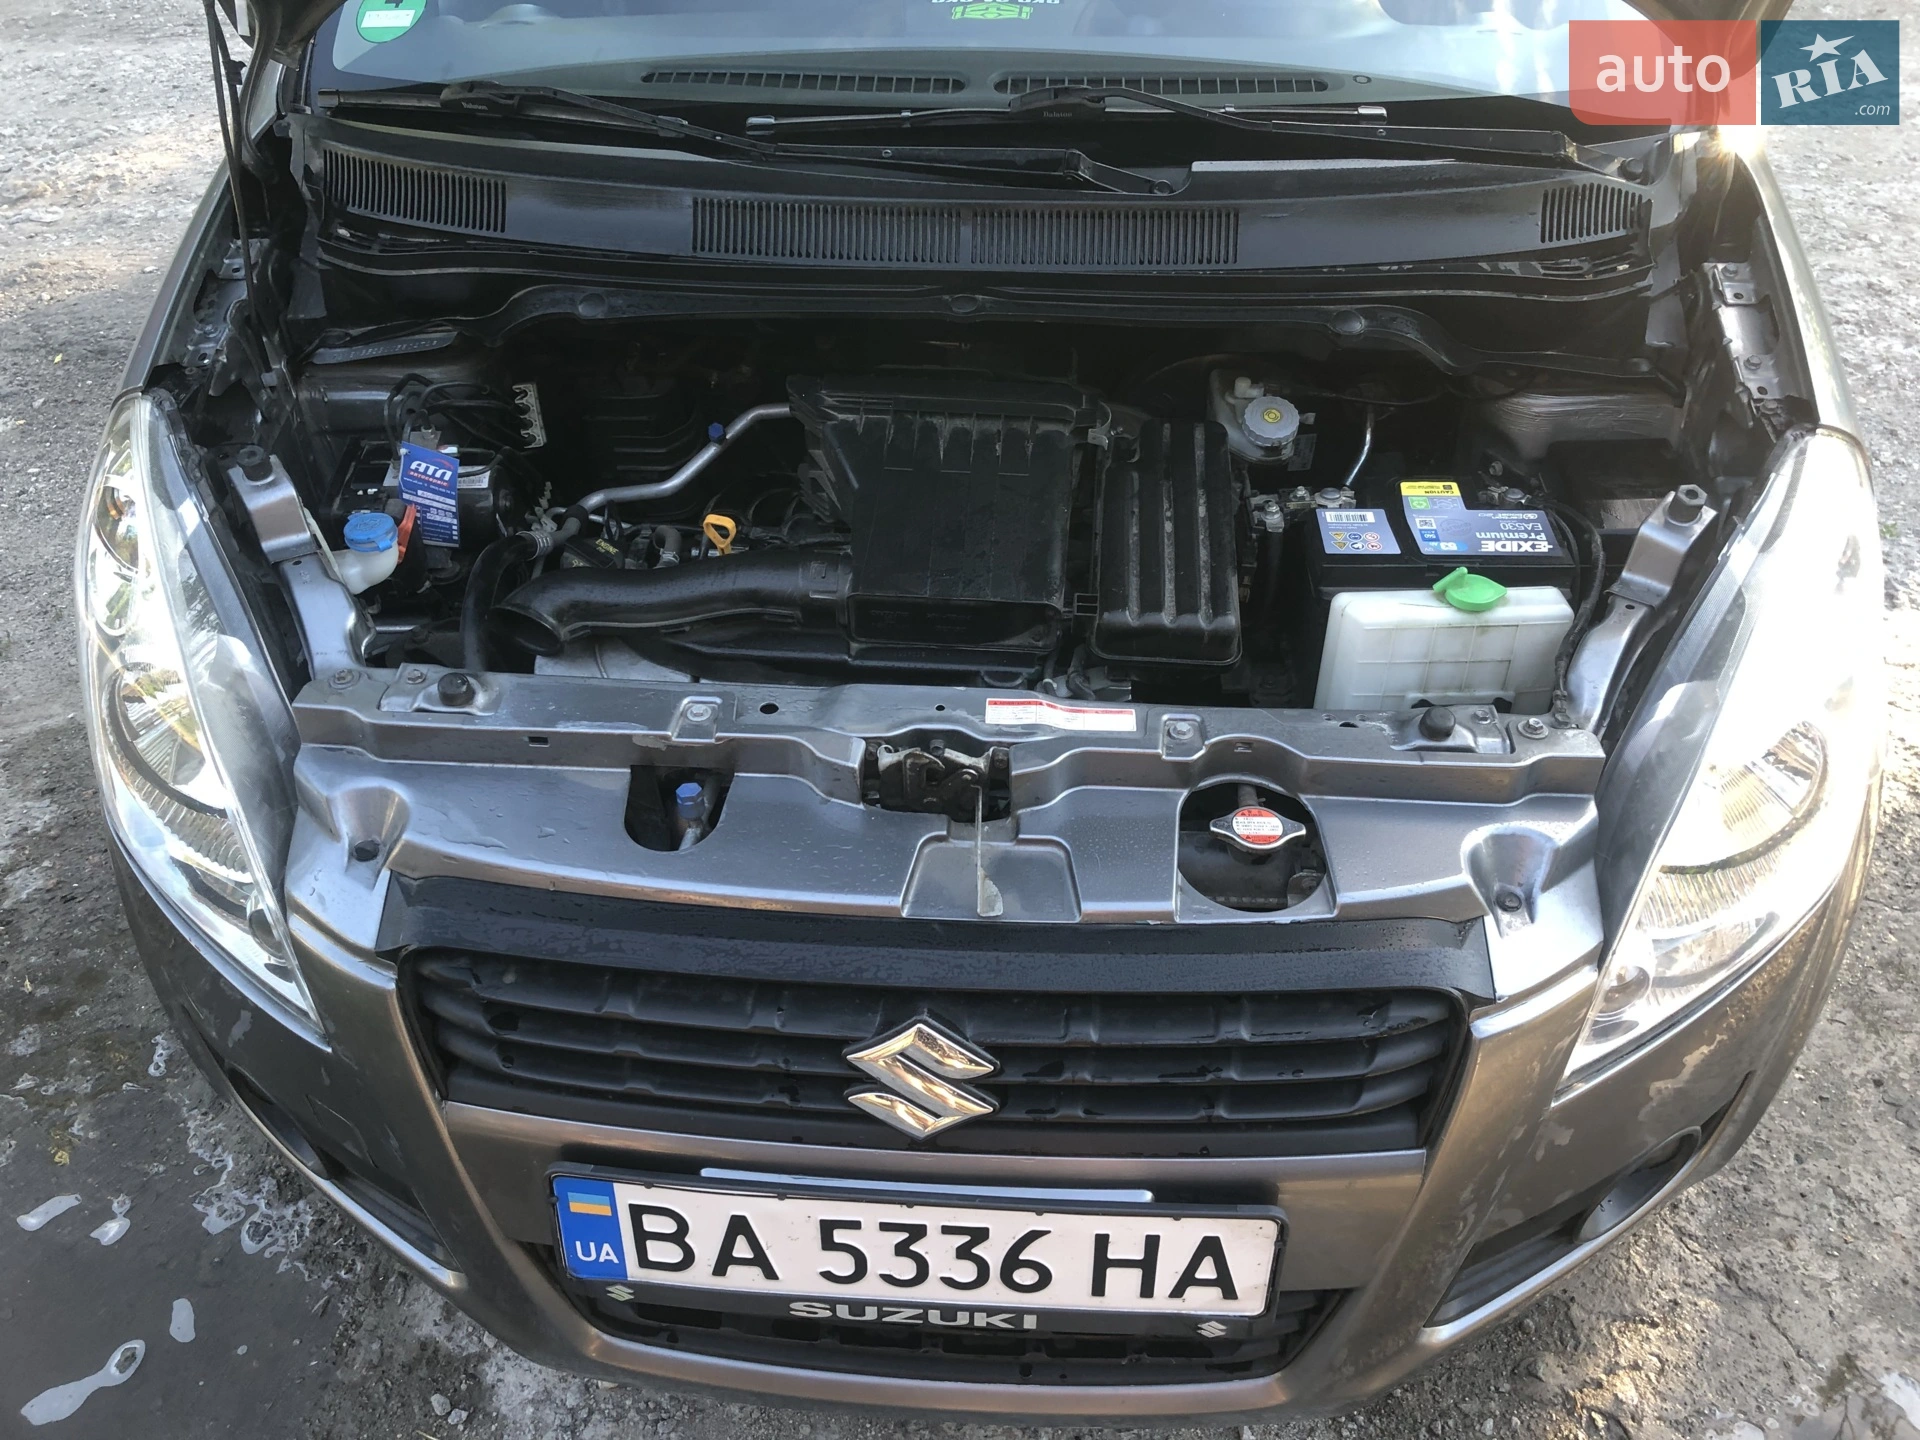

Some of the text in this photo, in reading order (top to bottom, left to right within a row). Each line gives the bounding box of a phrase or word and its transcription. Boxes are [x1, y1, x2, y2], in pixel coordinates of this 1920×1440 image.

[1500, 522, 1543, 531] EA530
[1475, 532, 1547, 541] Premium
[1480, 540, 1553, 552] EXIDE
[575, 1241, 619, 1264] UA
[628, 1203, 1239, 1300] BA 5336 HA
[789, 1302, 1038, 1330] SUZUKI
